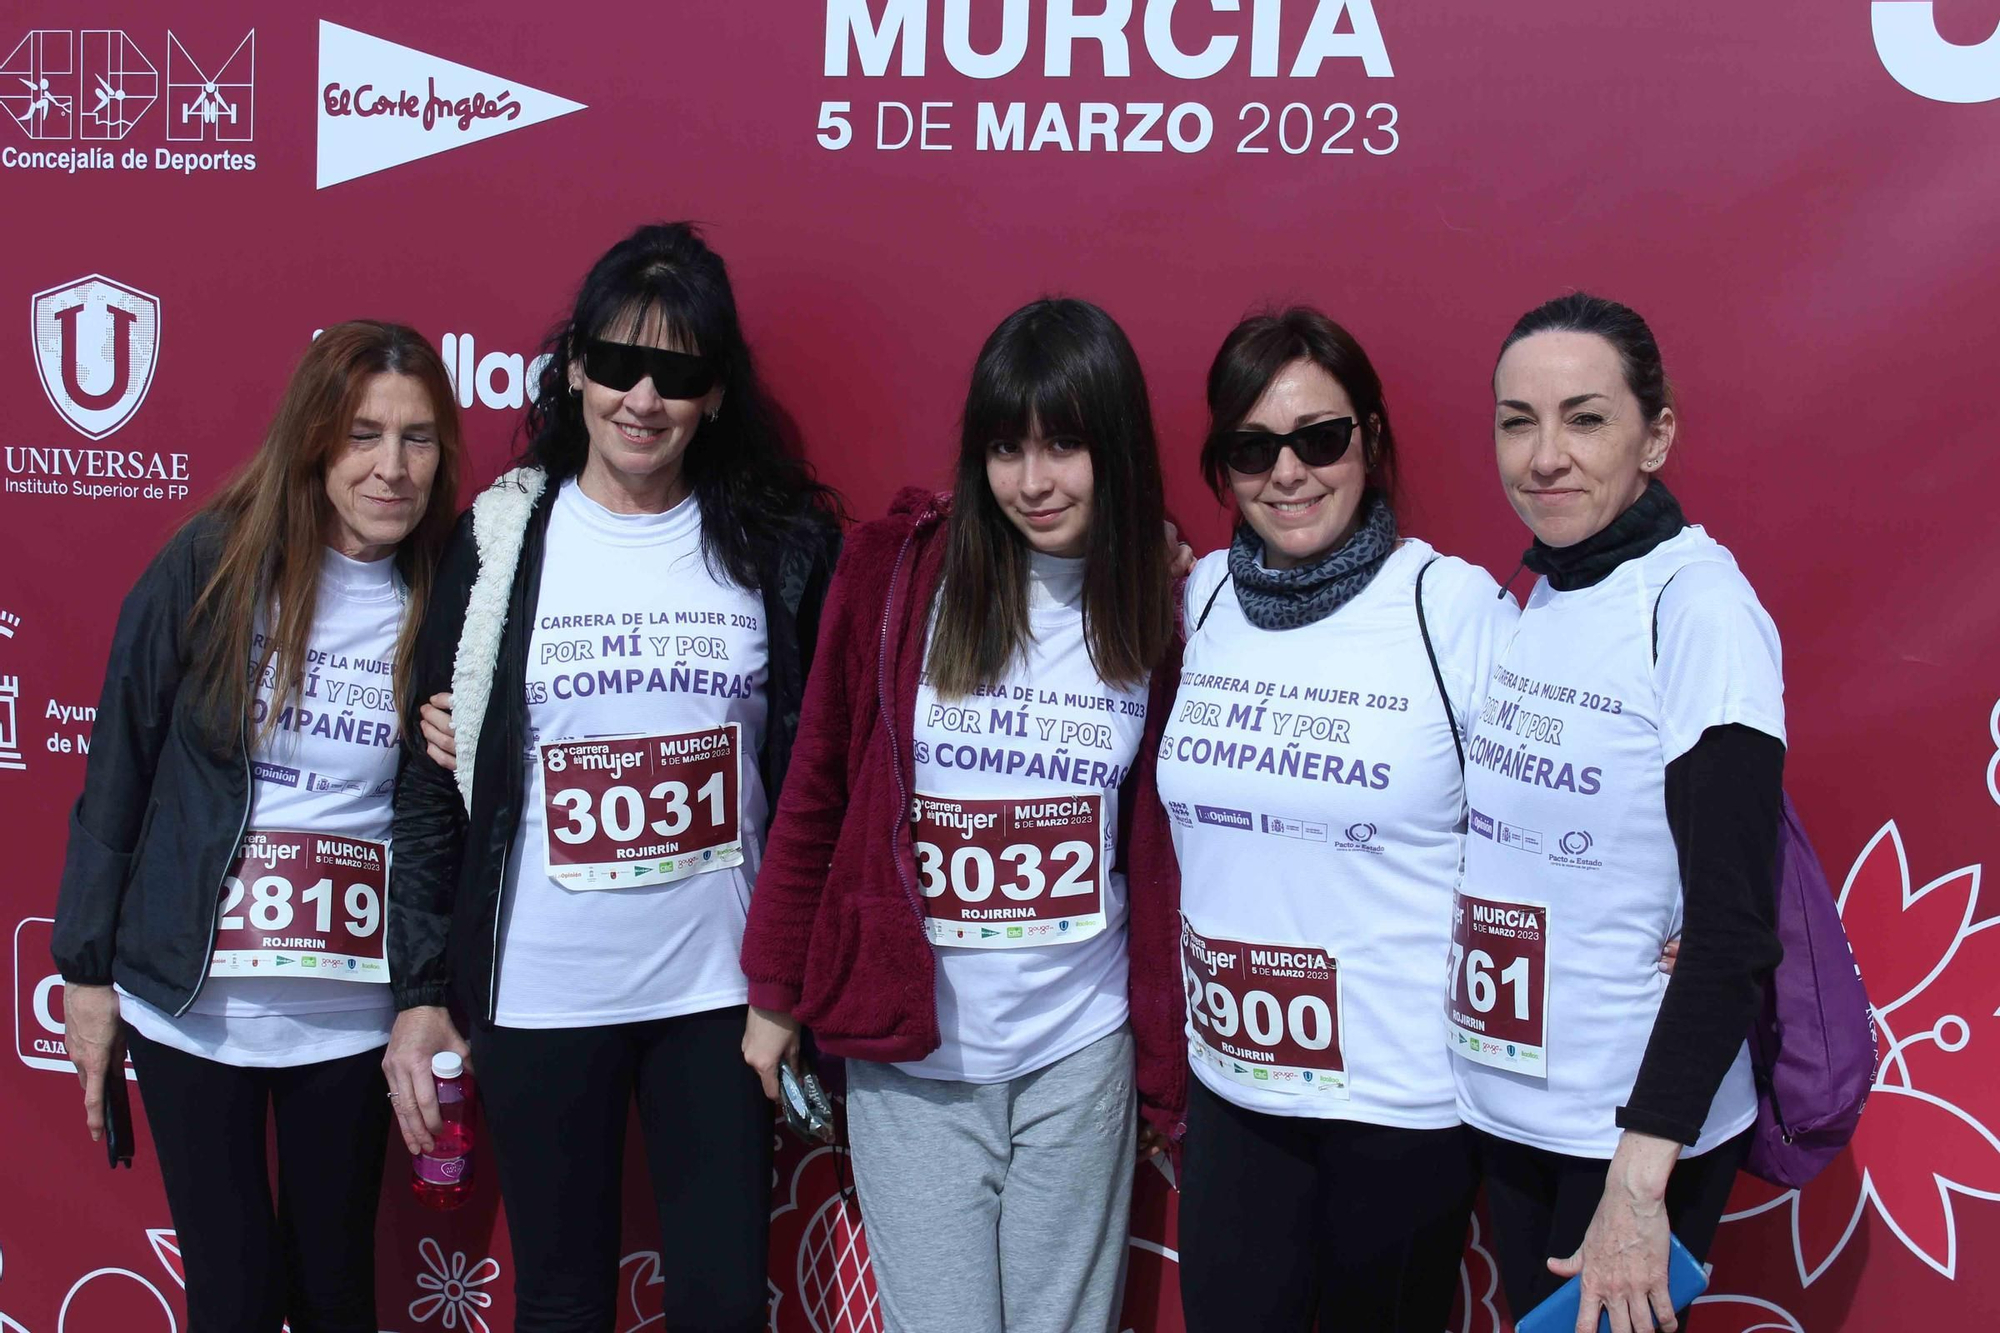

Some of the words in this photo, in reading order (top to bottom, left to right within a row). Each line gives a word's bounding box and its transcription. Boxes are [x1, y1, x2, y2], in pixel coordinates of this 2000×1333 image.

[824, 0, 1395, 79] MURCIA
[324, 83, 351, 116] El
[354, 84, 419, 118] Corte
[423, 77, 521, 131] Inglés
[816, 101, 853, 151] 5
[877, 102, 952, 151] DE
[976, 102, 1213, 153] MARZO
[1237, 102, 1399, 155] 2023
[1, 147, 115, 174] Concejalía
[121, 148, 148, 170] de
[155, 148, 256, 174] Deportes
[4, 446, 190, 481] UNIVERSAE
[5, 477, 68, 495] Instituto
[72, 480, 139, 500] Superior
[143, 484, 164, 499] de
[168, 484, 189, 500] FP
[541, 614, 616, 630] CARRERA
[622, 613, 643, 626] DE
[649, 612, 669, 625] LA
[675, 612, 726, 627] MUJER
[730, 613, 758, 631] 2023
[307, 649, 327, 665] DE
[330, 655, 348, 669] LA
[541, 640, 595, 665] POR
[602, 627, 642, 657] MÍ
[648, 636, 670, 657] Y
[676, 635, 729, 661] POR
[326, 680, 345, 703] Y
[347, 684, 395, 712] POR
[524, 681, 548, 704] IS
[552, 661, 753, 700] COMPAÑERAS
[1193, 673, 1249, 694] CARRERA
[1254, 681, 1276, 697] DE
[1279, 684, 1298, 700] LA
[1304, 687, 1360, 706] MUJER
[1366, 693, 1409, 712] 2023
[1517, 676, 1530, 693] DE
[1528, 680, 1540, 697] LA
[1540, 683, 1577, 704] MUJER
[1579, 691, 1623, 715] 2023
[45, 698, 97, 725] Ayun
[1013, 686, 1034, 702] DE
[1039, 690, 1058, 706] LA
[1064, 693, 1116, 713] MUJER
[1120, 700, 1145, 719] 2023
[927, 704, 982, 734] POR
[989, 704, 1029, 738] MÍ
[1036, 717, 1057, 741] Y
[1061, 720, 1113, 750] POR
[1179, 700, 1222, 727] POR
[1226, 699, 1267, 732] MÍ
[1272, 712, 1292, 735] Y
[1293, 714, 1350, 744] POR
[1495, 695, 1523, 731] MÍ
[1515, 710, 1530, 736] Y
[1525, 713, 1563, 746] POR
[46, 732, 72, 753] de
[569, 745, 610, 755] carrera
[660, 733, 730, 756] MURCIA
[582, 751, 644, 780] mujer
[661, 758, 667, 766] 5
[669, 756, 681, 765] DE
[682, 751, 711, 763] MARZO
[711, 748, 731, 758] 2023
[1177, 736, 1391, 791] COMPAÑERAS
[1469, 734, 1603, 796] COMPAÑERAS
[552, 772, 725, 845] 3031
[924, 800, 962, 812] carrera
[1014, 801, 1091, 820] MURCIA
[935, 810, 998, 840] mujer
[1014, 821, 1021, 829] 5
[1022, 820, 1034, 828] DE
[1036, 818, 1069, 827] MARZO
[1070, 815, 1093, 824] 2023
[238, 843, 301, 870] mujer
[316, 839, 379, 863] MURCIA
[323, 856, 334, 865] DE
[335, 858, 362, 868] MARZO
[363, 862, 381, 872] 2023
[616, 841, 679, 860] ROJIRRÍN
[916, 840, 1095, 902] 3032
[219, 875, 380, 938] 2819
[961, 907, 1037, 920] ROJIRRINA
[1473, 904, 1539, 930] MURCIA
[262, 937, 326, 949] ROJIRRIN
[1473, 922, 1478, 931] 5
[1478, 924, 1487, 933] DE
[1488, 925, 1516, 938] MARZO
[1517, 930, 1540, 941] 2023
[1190, 942, 1237, 977] mujer
[1250, 949, 1328, 970] MURCIA
[1251, 966, 1258, 974] 5
[1259, 967, 1271, 976] DE
[1272, 969, 1305, 978] MARZO
[1306, 971, 1329, 980] 2023
[1450, 940, 1529, 1021] 761
[1187, 965, 1332, 1050] 2900
[1453, 1009, 1486, 1032] ROJIRRIN
[34, 1039, 67, 1055] CAJA
[1221, 1042, 1275, 1062] ROJIRRIN
